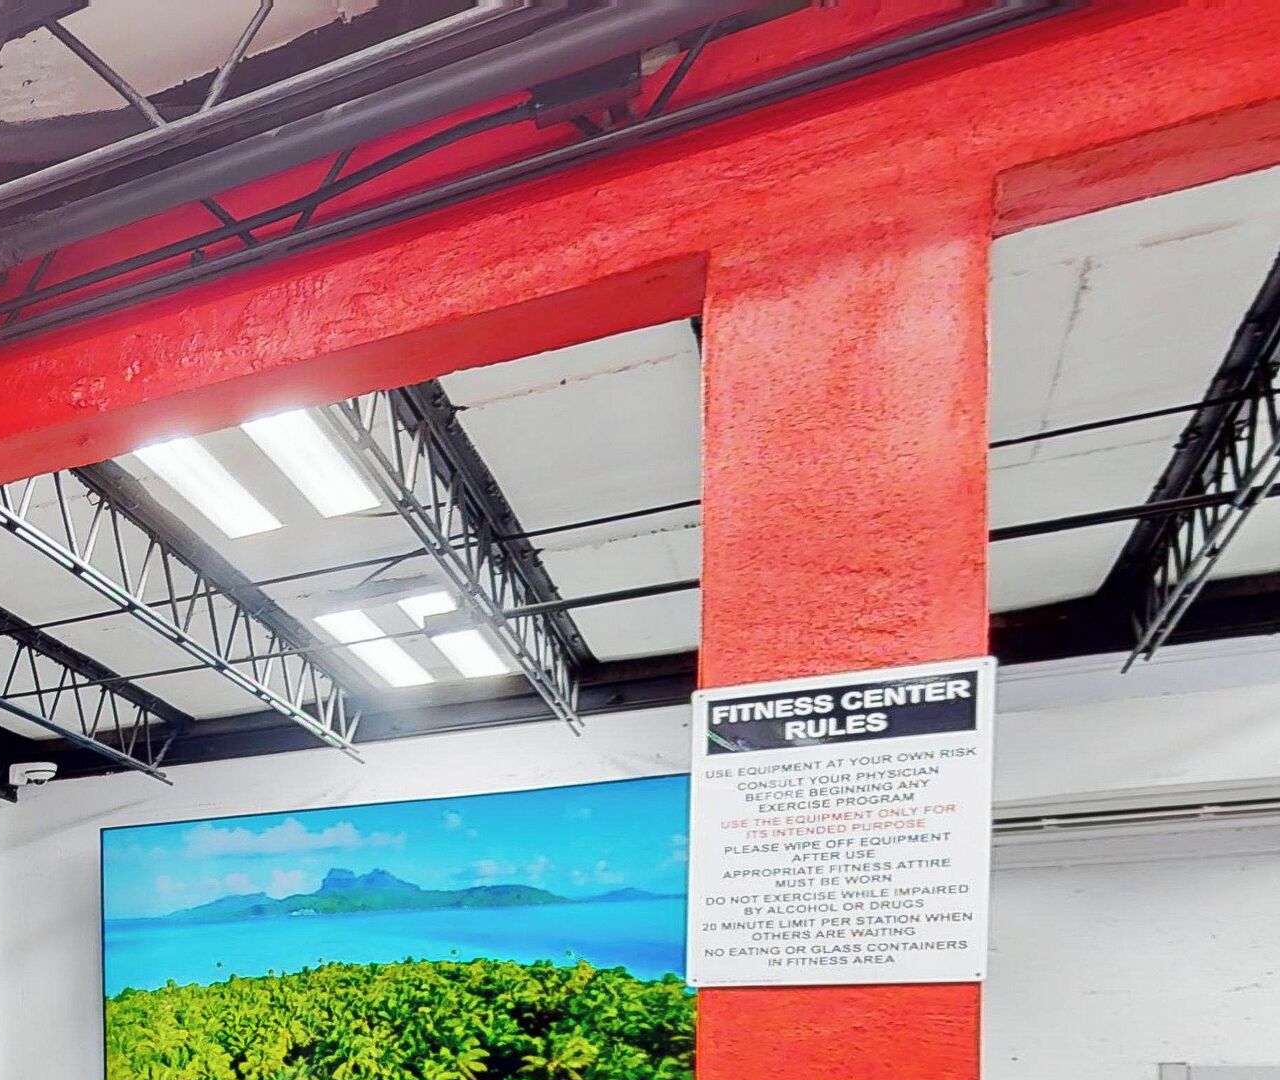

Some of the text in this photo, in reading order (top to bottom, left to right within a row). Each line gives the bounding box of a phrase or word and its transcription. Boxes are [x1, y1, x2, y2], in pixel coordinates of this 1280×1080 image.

[711, 679, 972, 725] FITNESS CENTER
[784, 712, 888, 741] RULES
[705, 747, 977, 779] USE EQUIPMENT AT YOUR OWN RISK
[737, 766, 939, 791] CONSULT YOUR PHYSICIAN
[745, 779, 930, 802] BEFORE BEGINNING ANY
[758, 793, 915, 813] EXERCISE PROGRAM
[721, 804, 956, 829] USE THE EQUIPMENT ONLY FOR
[746, 818, 925, 840] ITS INTENDED PURPOSE
[724, 831, 951, 855] PLEASE WIPE OFF EQUIPMENT
[792, 849, 876, 862] AFTER USE
[722, 858, 952, 879] APPROPRIATE FITNESS ATTIRE
[775, 874, 893, 888] MUST BE WORN
[705, 884, 969, 906] DO NOT EXERCISE WHILE IMPAIRED
[744, 898, 925, 916] BY ALCOHOL OR DRUGS
[702, 911, 973, 932] 20 MINUTE LIMIT PER STATION WHEN
[752, 926, 916, 941] OTHERS ARE WAITING
[704, 939, 969, 958] NO EATING OR GLASS CONTAINERS
[768, 955, 896, 967] IN FITNESS AREA
